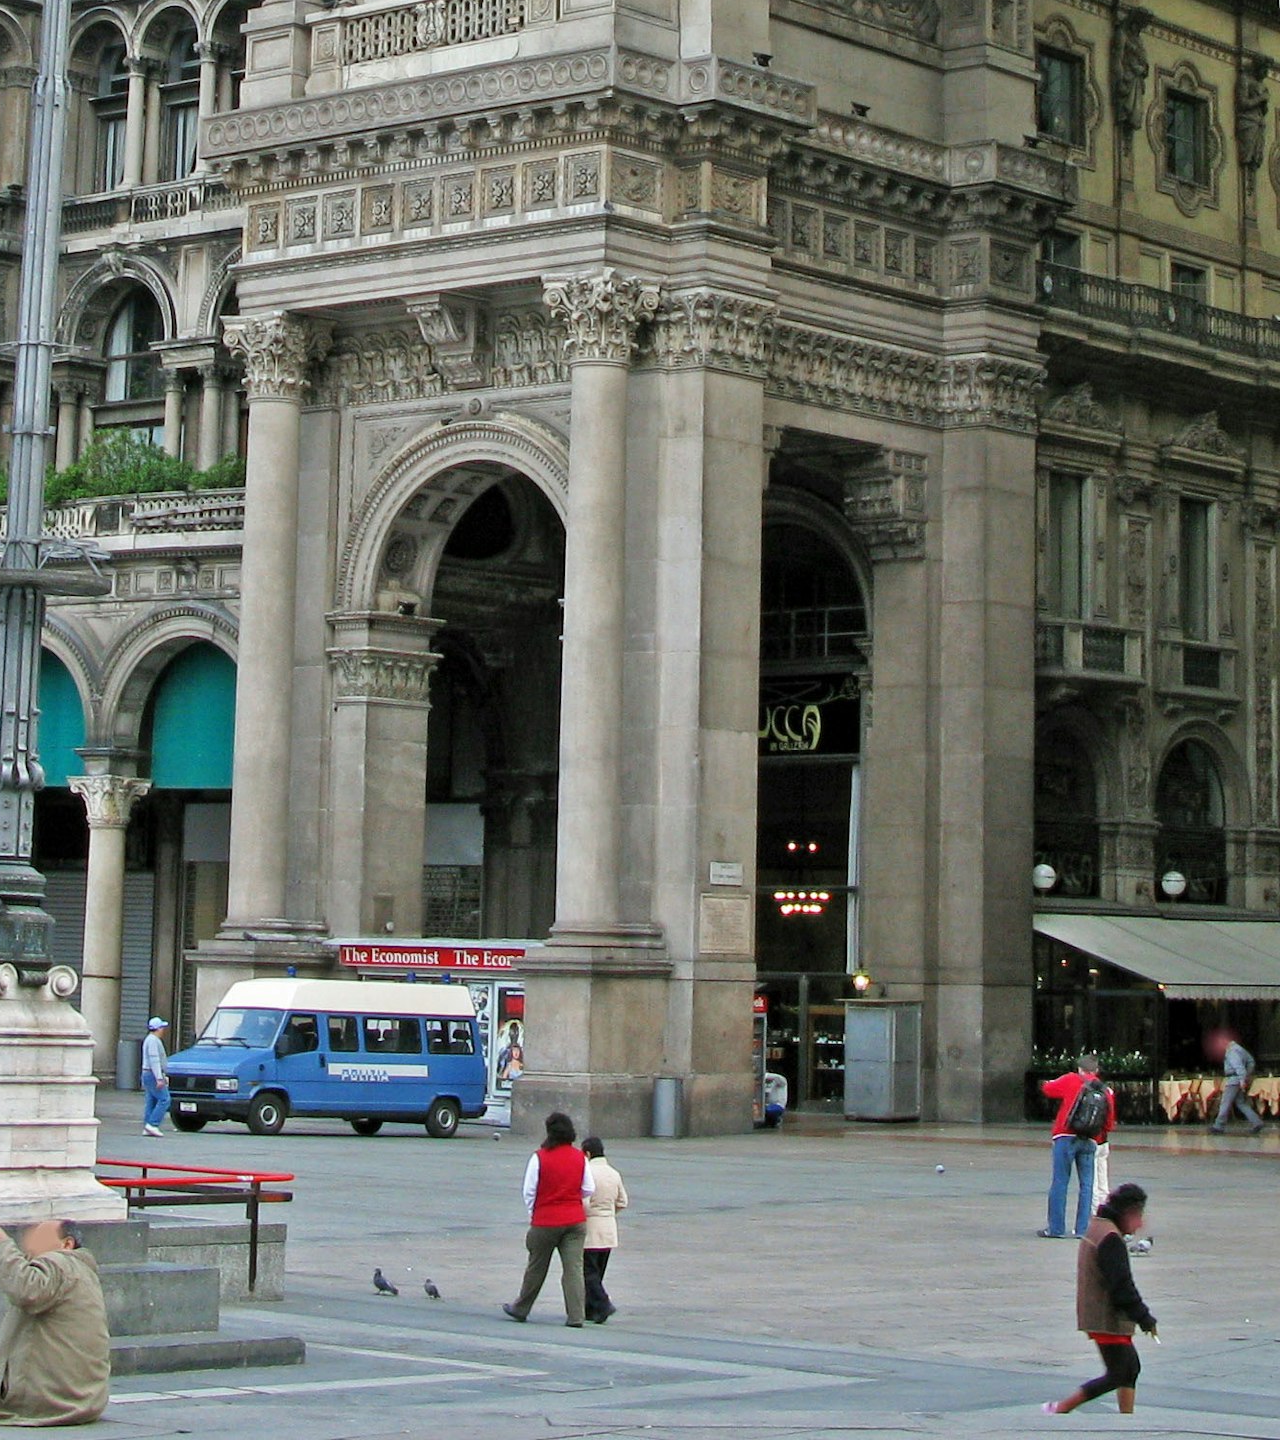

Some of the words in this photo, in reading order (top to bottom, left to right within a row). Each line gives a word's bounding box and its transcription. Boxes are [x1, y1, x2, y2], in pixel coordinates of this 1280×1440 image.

[344, 947, 367, 963] The
[371, 948, 439, 965] Economist
[453, 950, 479, 966] The
[341, 1068, 390, 1082] POLIZIA
